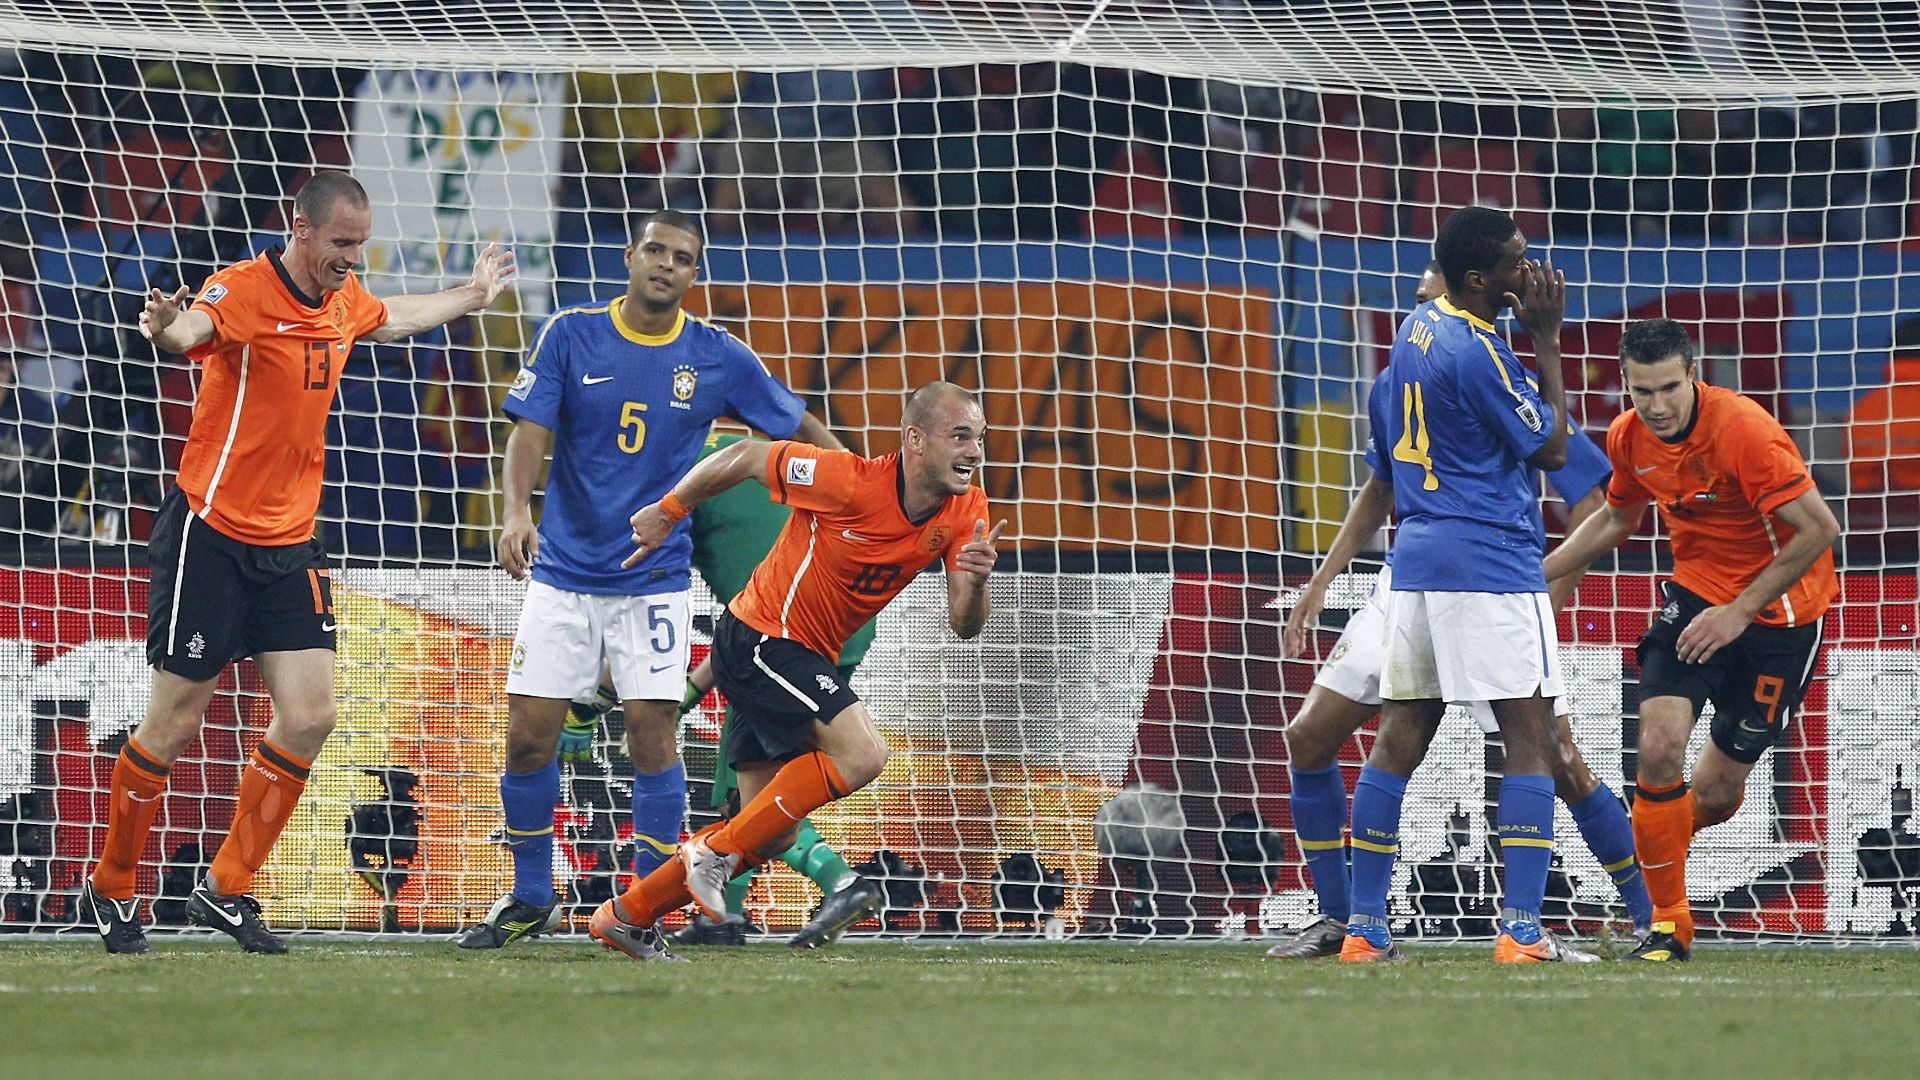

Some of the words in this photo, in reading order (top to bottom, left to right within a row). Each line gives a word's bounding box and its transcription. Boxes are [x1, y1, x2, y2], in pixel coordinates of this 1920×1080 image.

[1407, 319, 1434, 356] JUAN
[303, 341, 331, 390] 13
[616, 401, 648, 454] 5
[669, 400, 692, 411] BRASIL
[1392, 381, 1440, 491] 4
[849, 564, 903, 596] 10
[647, 604, 676, 654] 5
[1754, 674, 1784, 724] 9
